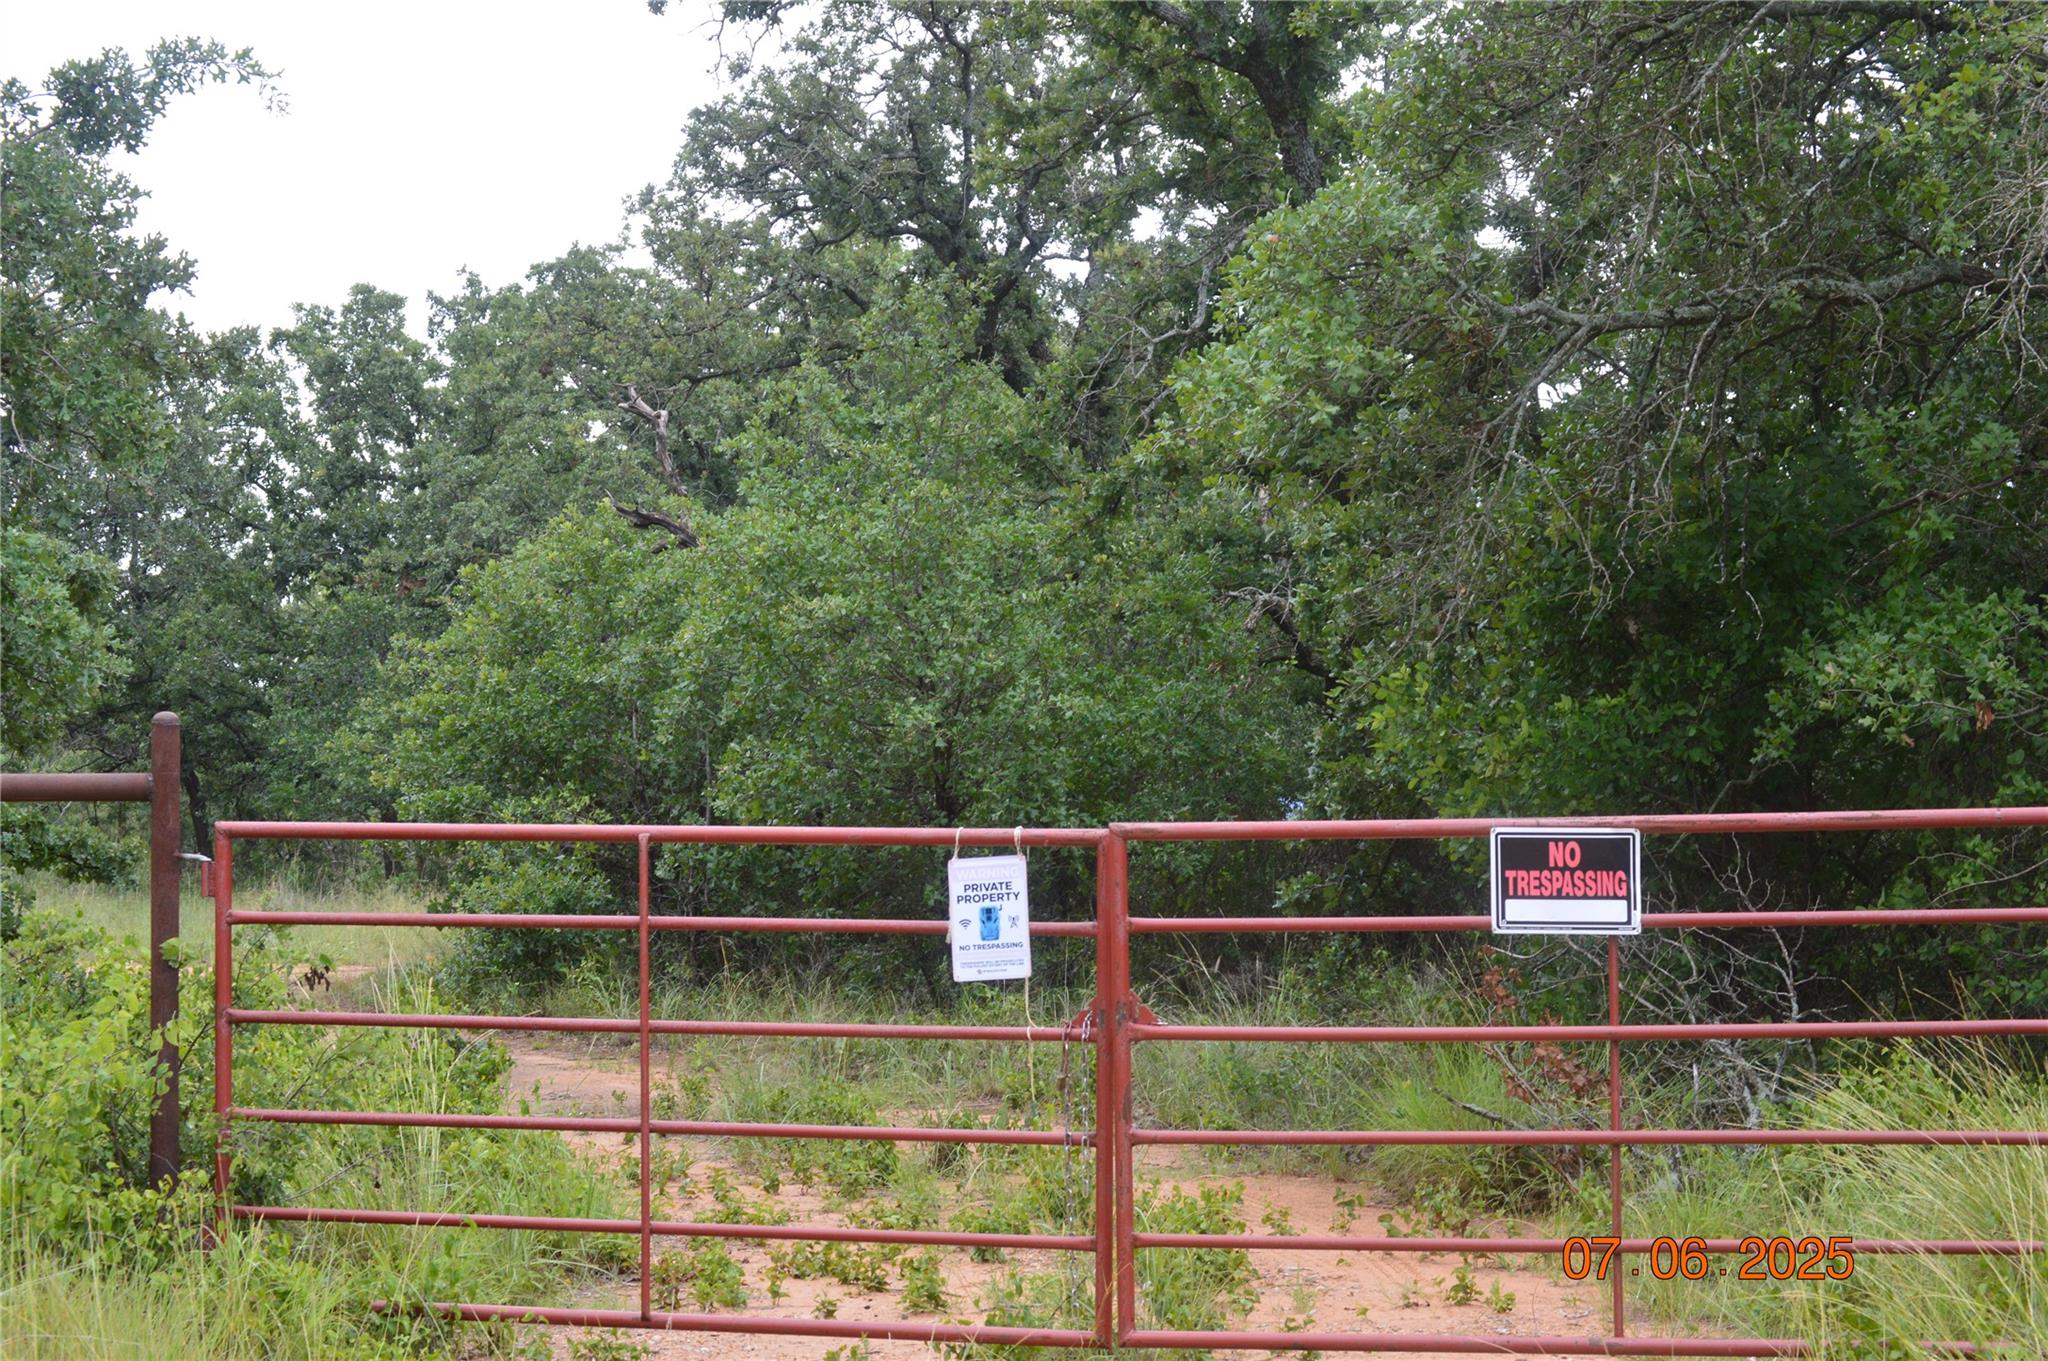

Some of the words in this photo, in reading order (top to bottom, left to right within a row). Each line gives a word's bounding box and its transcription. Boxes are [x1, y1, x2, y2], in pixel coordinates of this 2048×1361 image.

[1548, 841, 1581, 868] NO
[956, 867, 1019, 881] WARNING
[964, 881, 1012, 893] PRIVATE
[1505, 870, 1627, 897] TRESPASSING
[957, 892, 1020, 904] PROPERTY
[972, 941, 1023, 950] TRESPASSING
